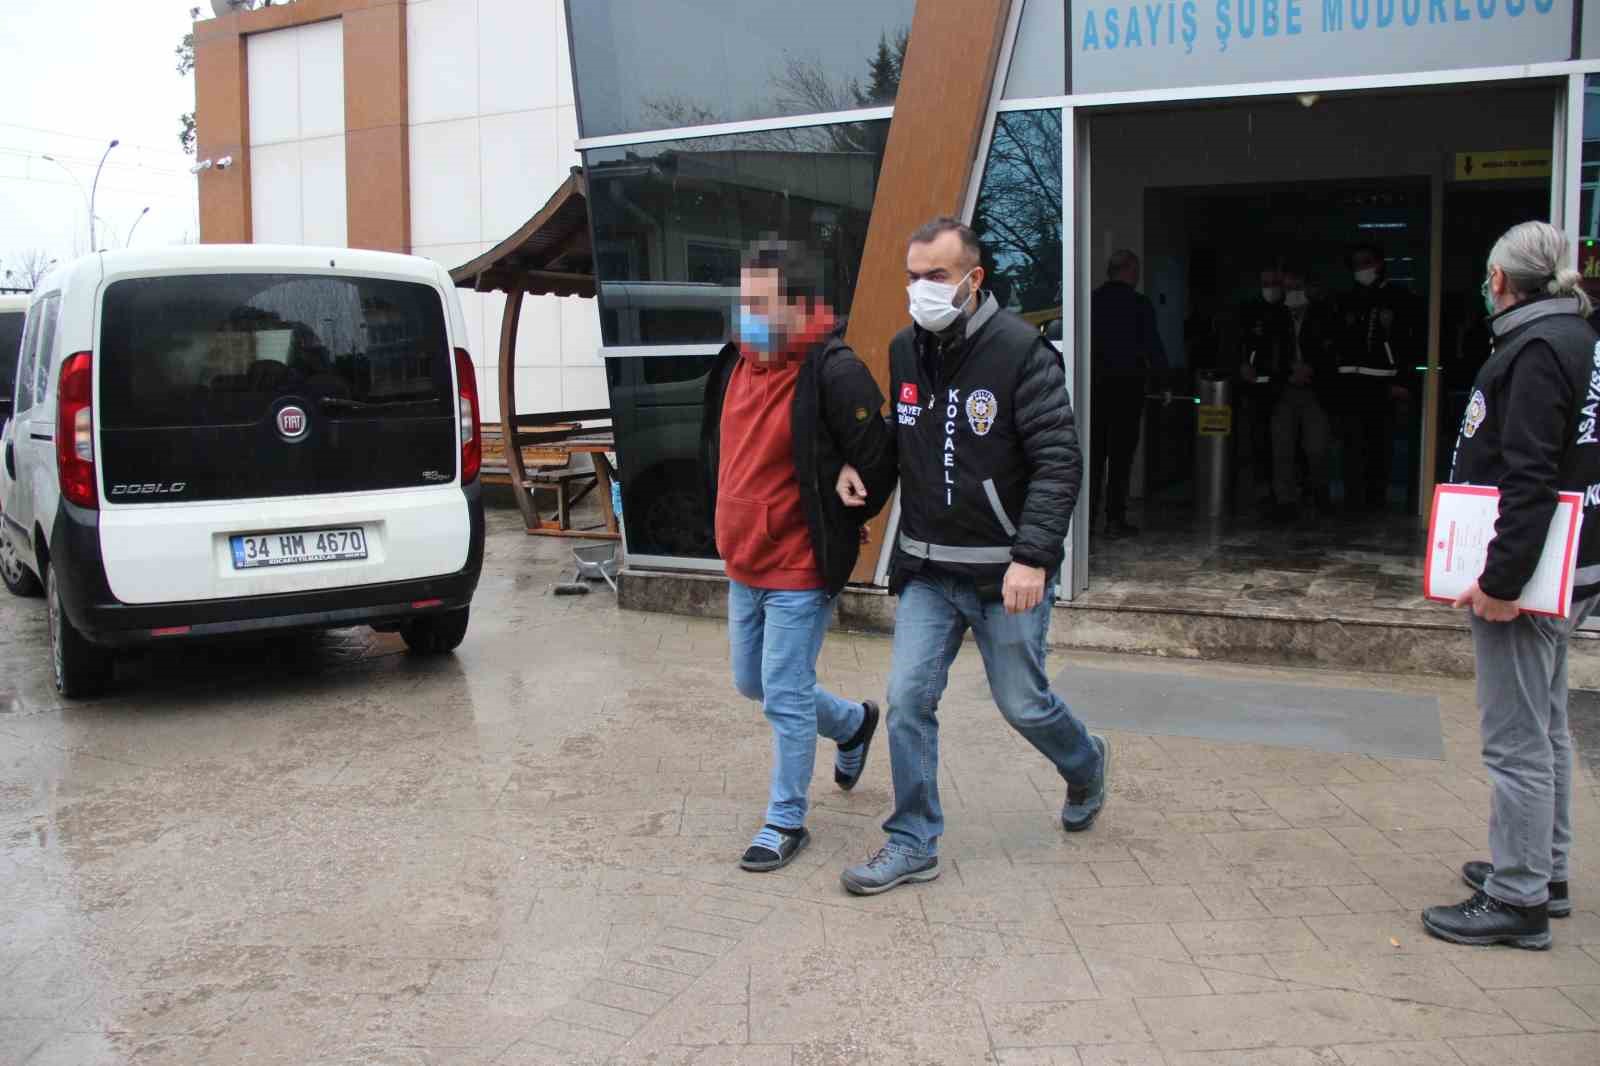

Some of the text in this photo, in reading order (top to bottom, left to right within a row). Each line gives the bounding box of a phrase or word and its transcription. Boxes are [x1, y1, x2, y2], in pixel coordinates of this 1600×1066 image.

[1082, 1, 1198, 54] ASAYİŞ
[1215, 0, 1303, 53] ŞUBE
[284, 415, 301, 429] FIAT
[111, 482, 187, 495] DOBLO
[245, 531, 363, 559] 34 HM 4670
